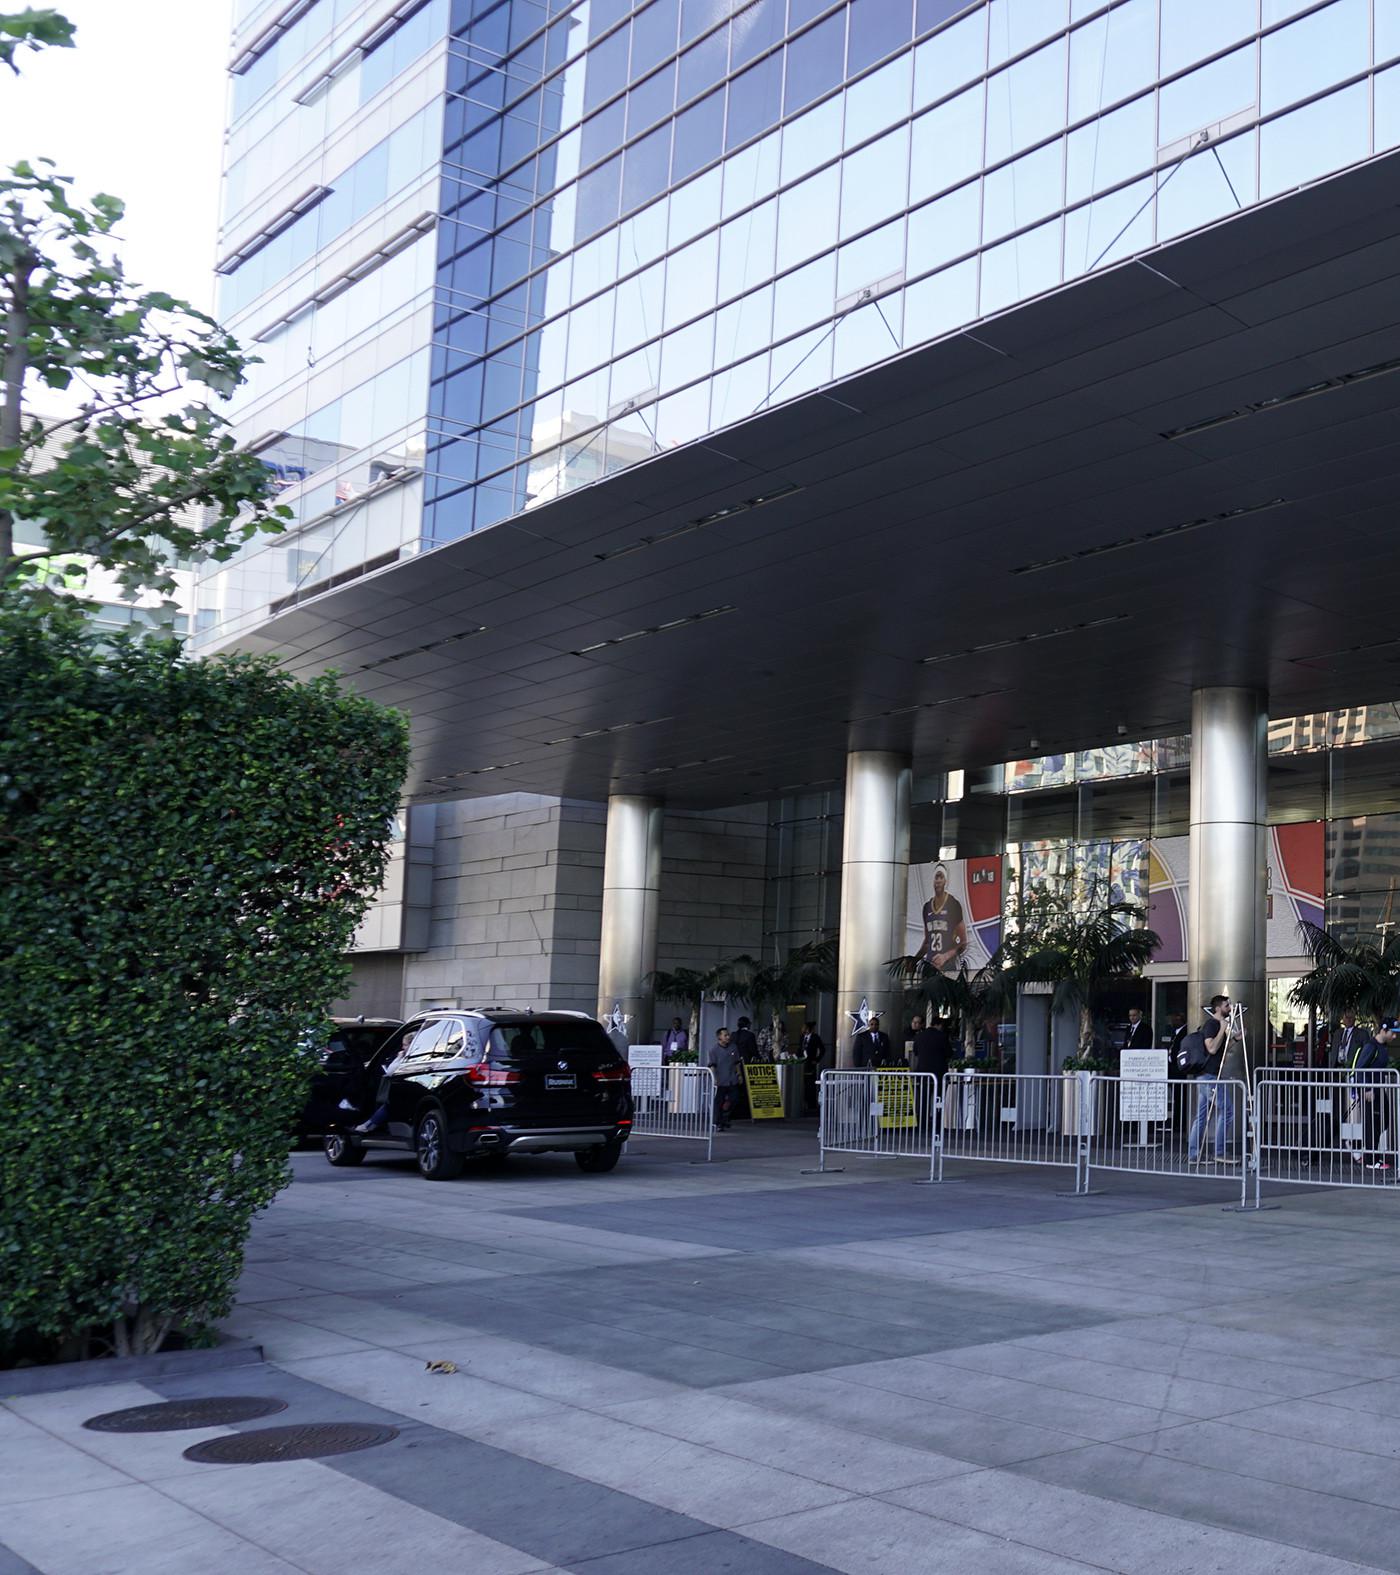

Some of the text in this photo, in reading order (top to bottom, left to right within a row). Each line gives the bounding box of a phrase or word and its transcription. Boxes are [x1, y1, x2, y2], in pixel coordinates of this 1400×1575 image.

[972, 873, 980, 884] LA
[930, 933, 943, 951] 23
[747, 1065, 776, 1076] NOTICE
